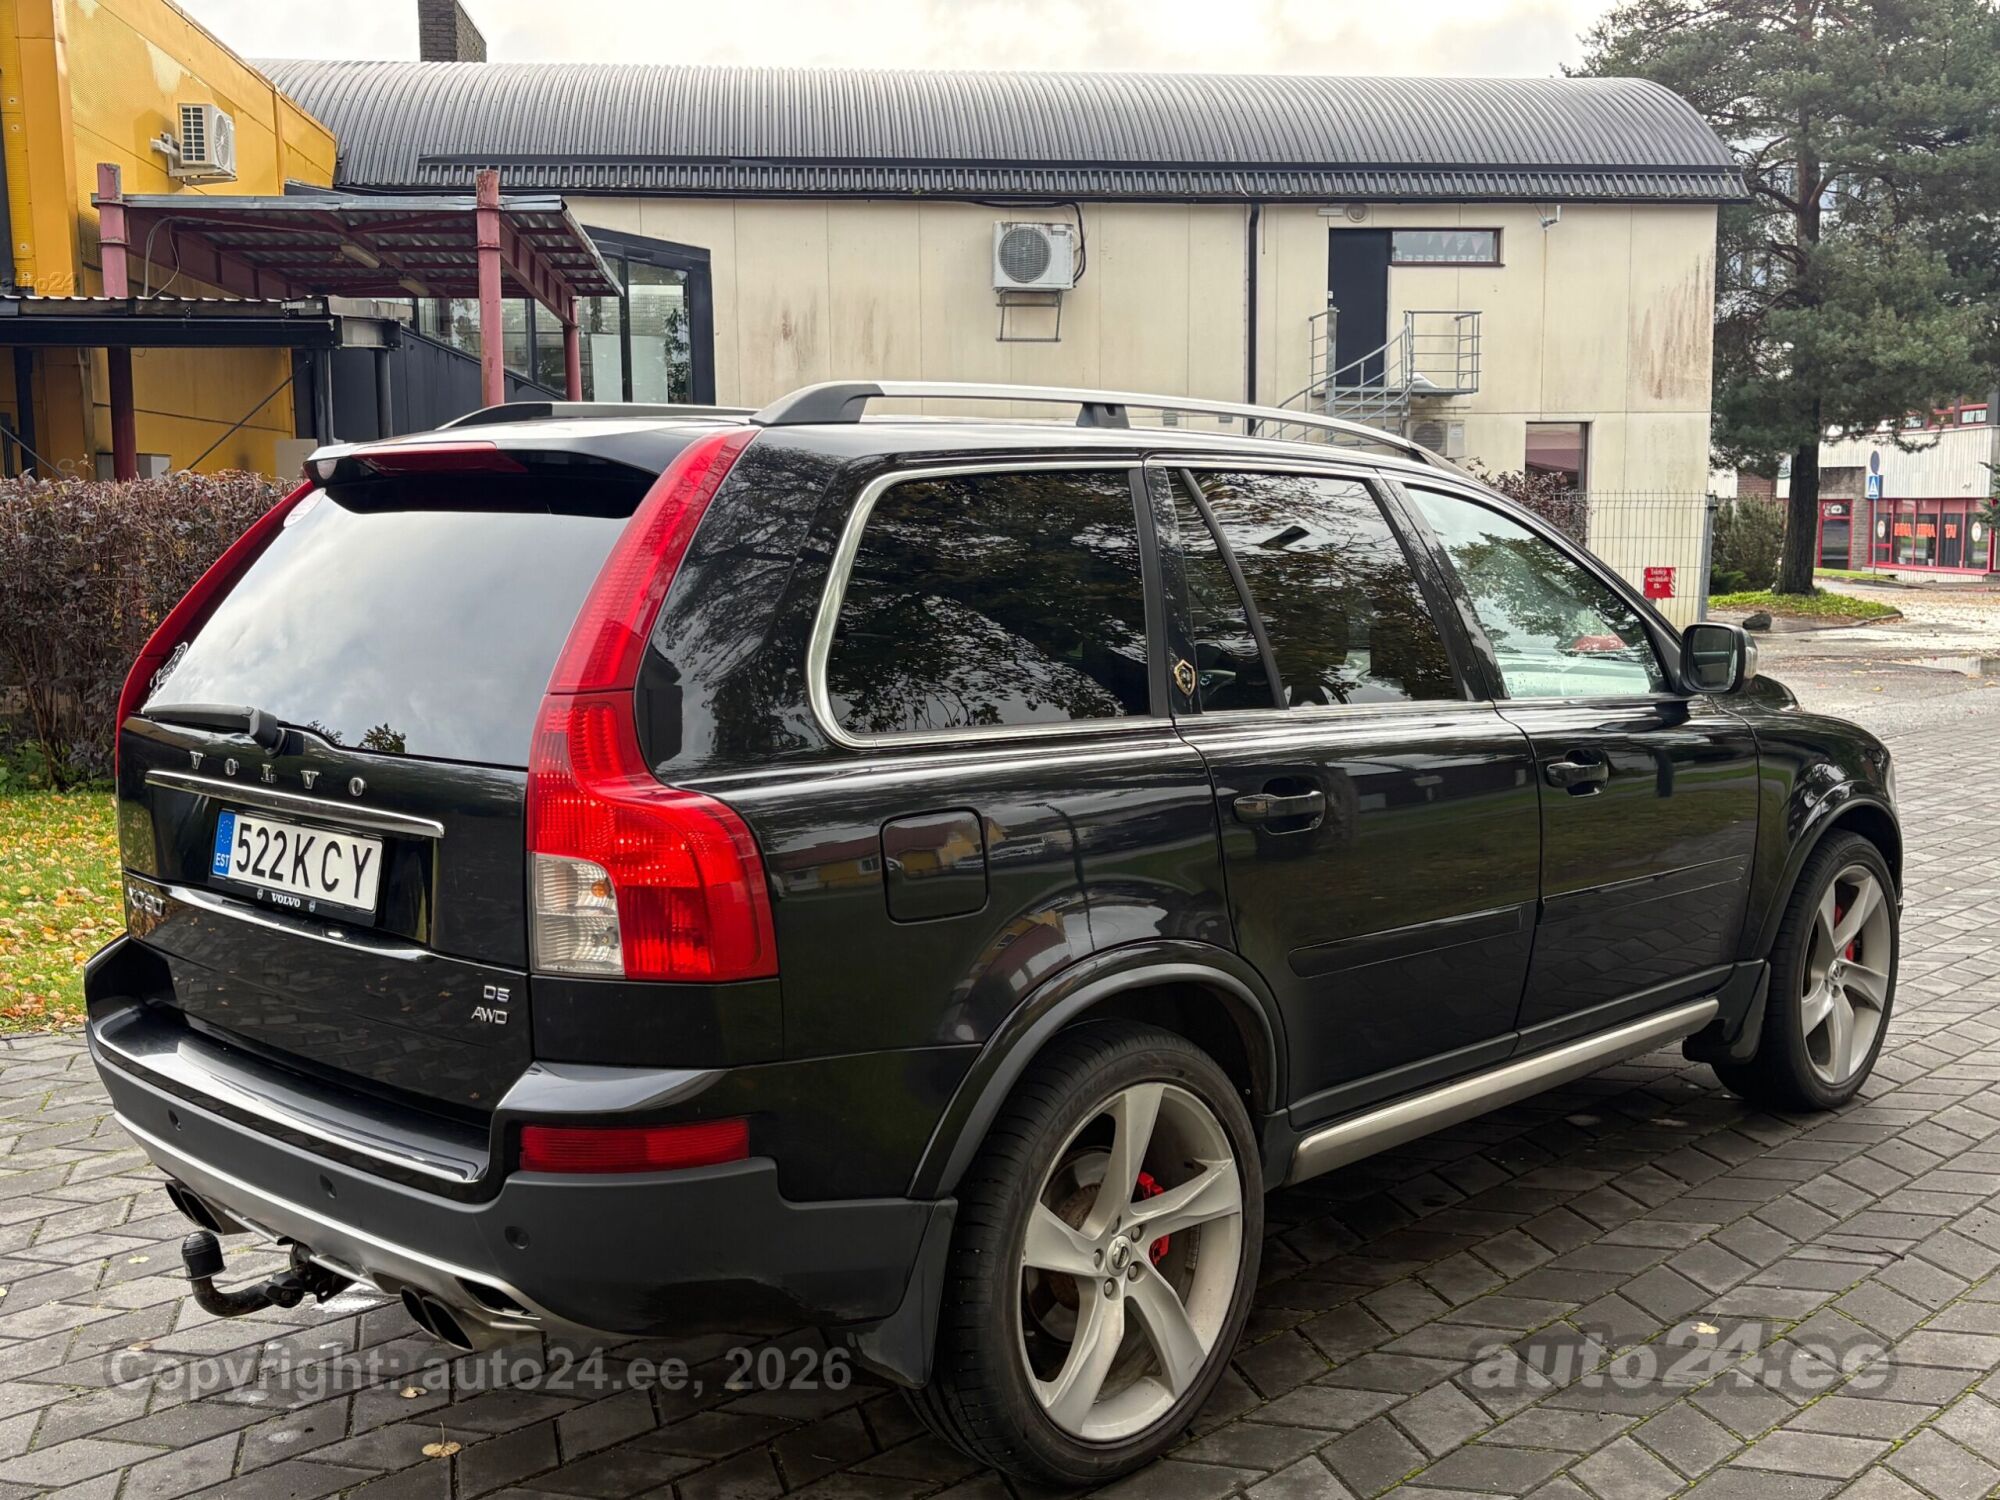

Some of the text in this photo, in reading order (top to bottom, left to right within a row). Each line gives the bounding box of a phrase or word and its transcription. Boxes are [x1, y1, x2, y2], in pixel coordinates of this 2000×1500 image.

[189, 750, 367, 797] VOLVO
[215, 852, 230, 867] EST
[236, 822, 373, 899] 522KCY
[271, 892, 301, 908] VOLVO
[483, 984, 510, 1003] D5
[470, 1006, 508, 1025] AWD
